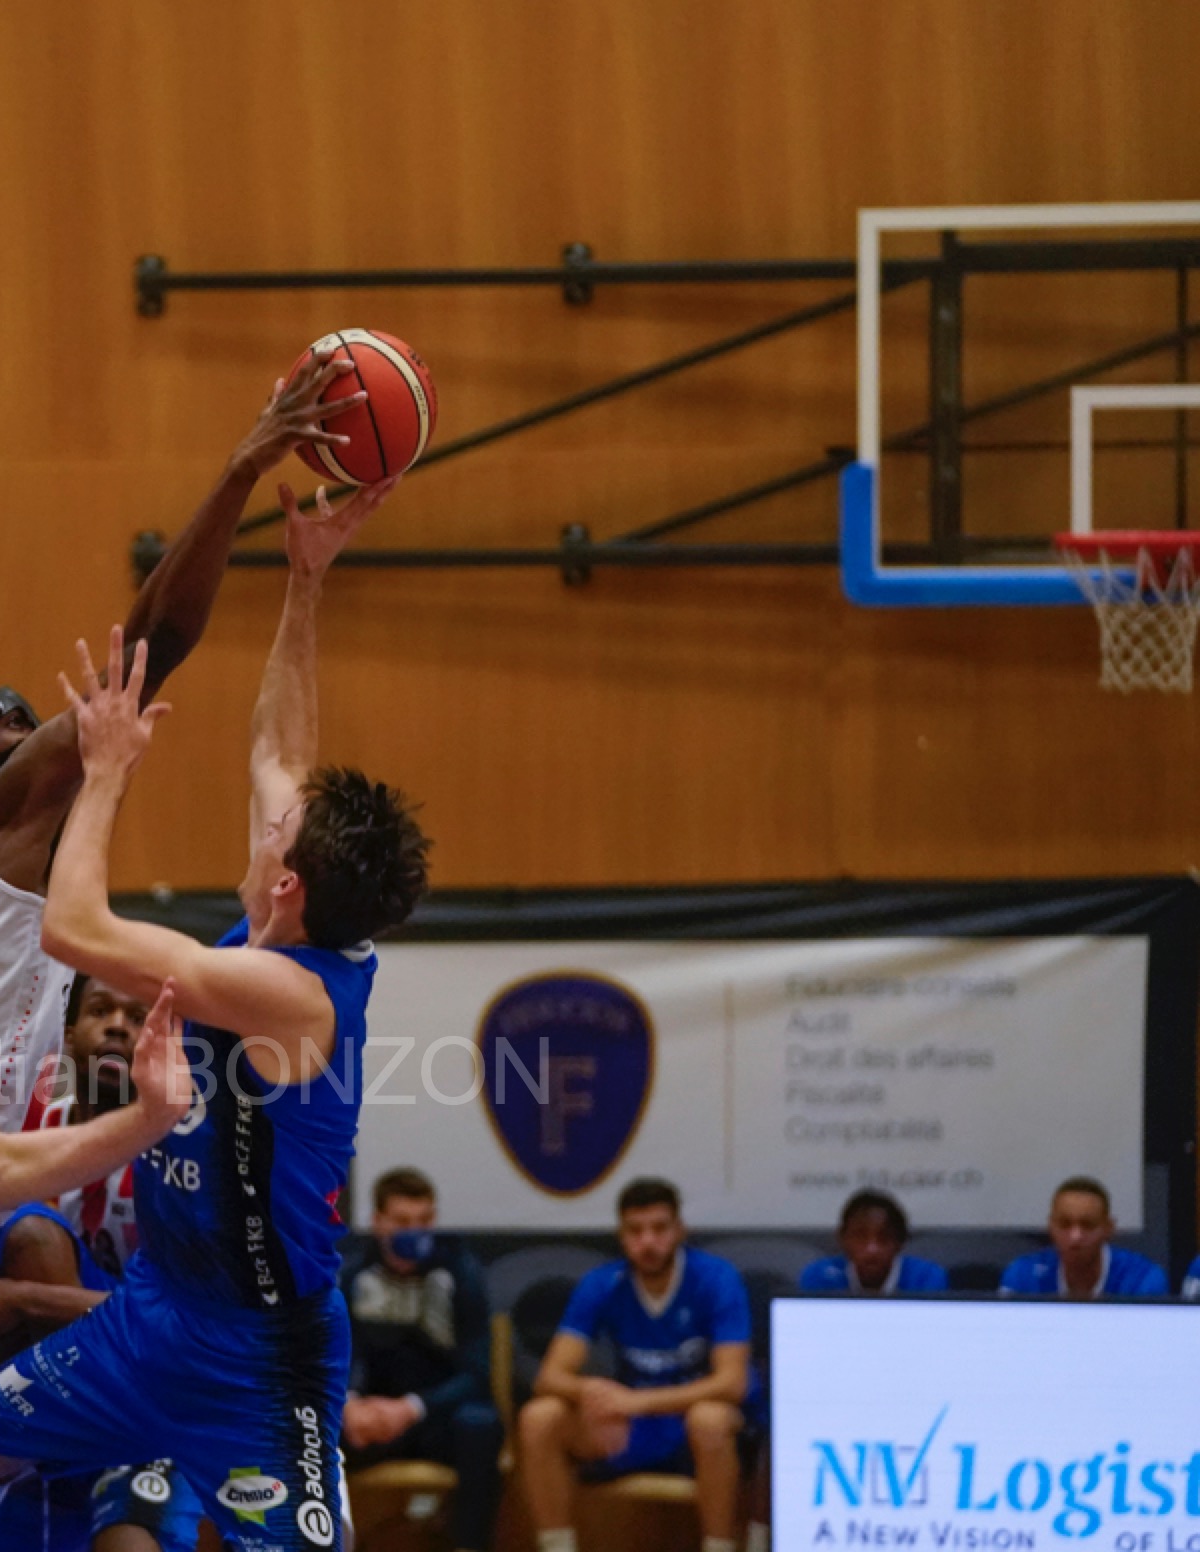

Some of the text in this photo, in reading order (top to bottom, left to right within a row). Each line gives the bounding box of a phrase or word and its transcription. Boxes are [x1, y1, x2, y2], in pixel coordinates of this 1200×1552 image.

[246, 1215, 265, 1253] FKB
[294, 1405, 325, 1500] groupe
[811, 1402, 948, 1509] NV
[813, 1519, 836, 1545] A
